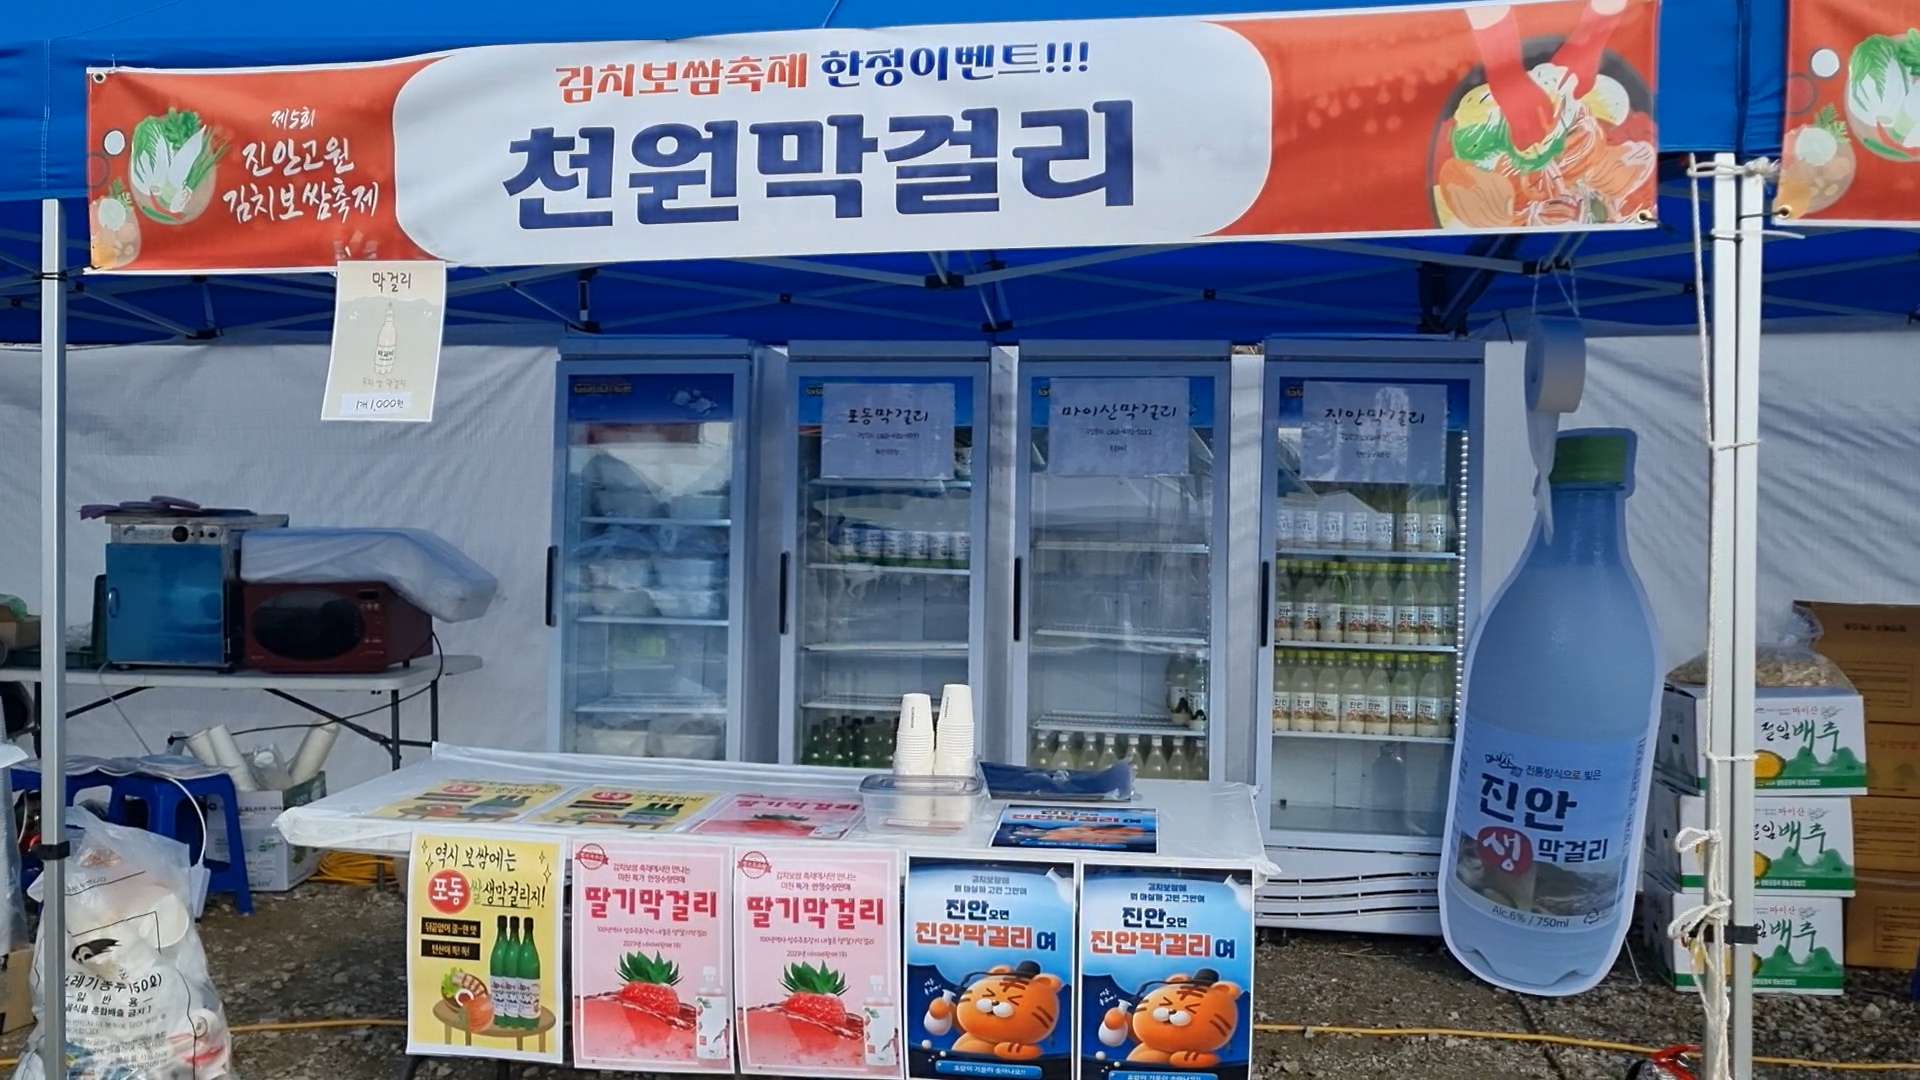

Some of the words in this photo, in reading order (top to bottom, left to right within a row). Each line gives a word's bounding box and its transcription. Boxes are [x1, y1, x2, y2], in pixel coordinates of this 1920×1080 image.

[554, 53, 808, 103] 김치보쌈축제
[820, 42, 1089, 90] 한정이벤트!!!
[271, 107, 315, 129] 제5회
[242, 136, 354, 177] 진안고원
[503, 100, 1134, 229] 천원막걸리
[222, 177, 380, 224] 김치보쌈축제
[372, 272, 412, 293] 막걸리
[848, 407, 929, 426] 포동막걸리
[1062, 402, 1177, 420] 마이산막걸리
[1324, 407, 1425, 427] 진안막걸리
[1526, 765, 1581, 780] 전통방식으로
[1480, 773, 1577, 832] 진안
[435, 842, 459, 868] 역시
[462, 845, 517, 872] 보쌈에는
[1483, 831, 1520, 872] 생
[1538, 838, 1608, 863] 막걸리
[432, 877, 464, 905] 포동
[585, 886, 717, 922] 딸기막걸리
[746, 896, 884, 930] 딸기막걸리
[1536, 915, 1570, 928] 750ml
[915, 921, 1032, 949] 진안막걸리
[1090, 930, 1211, 957] 진안막걸리
